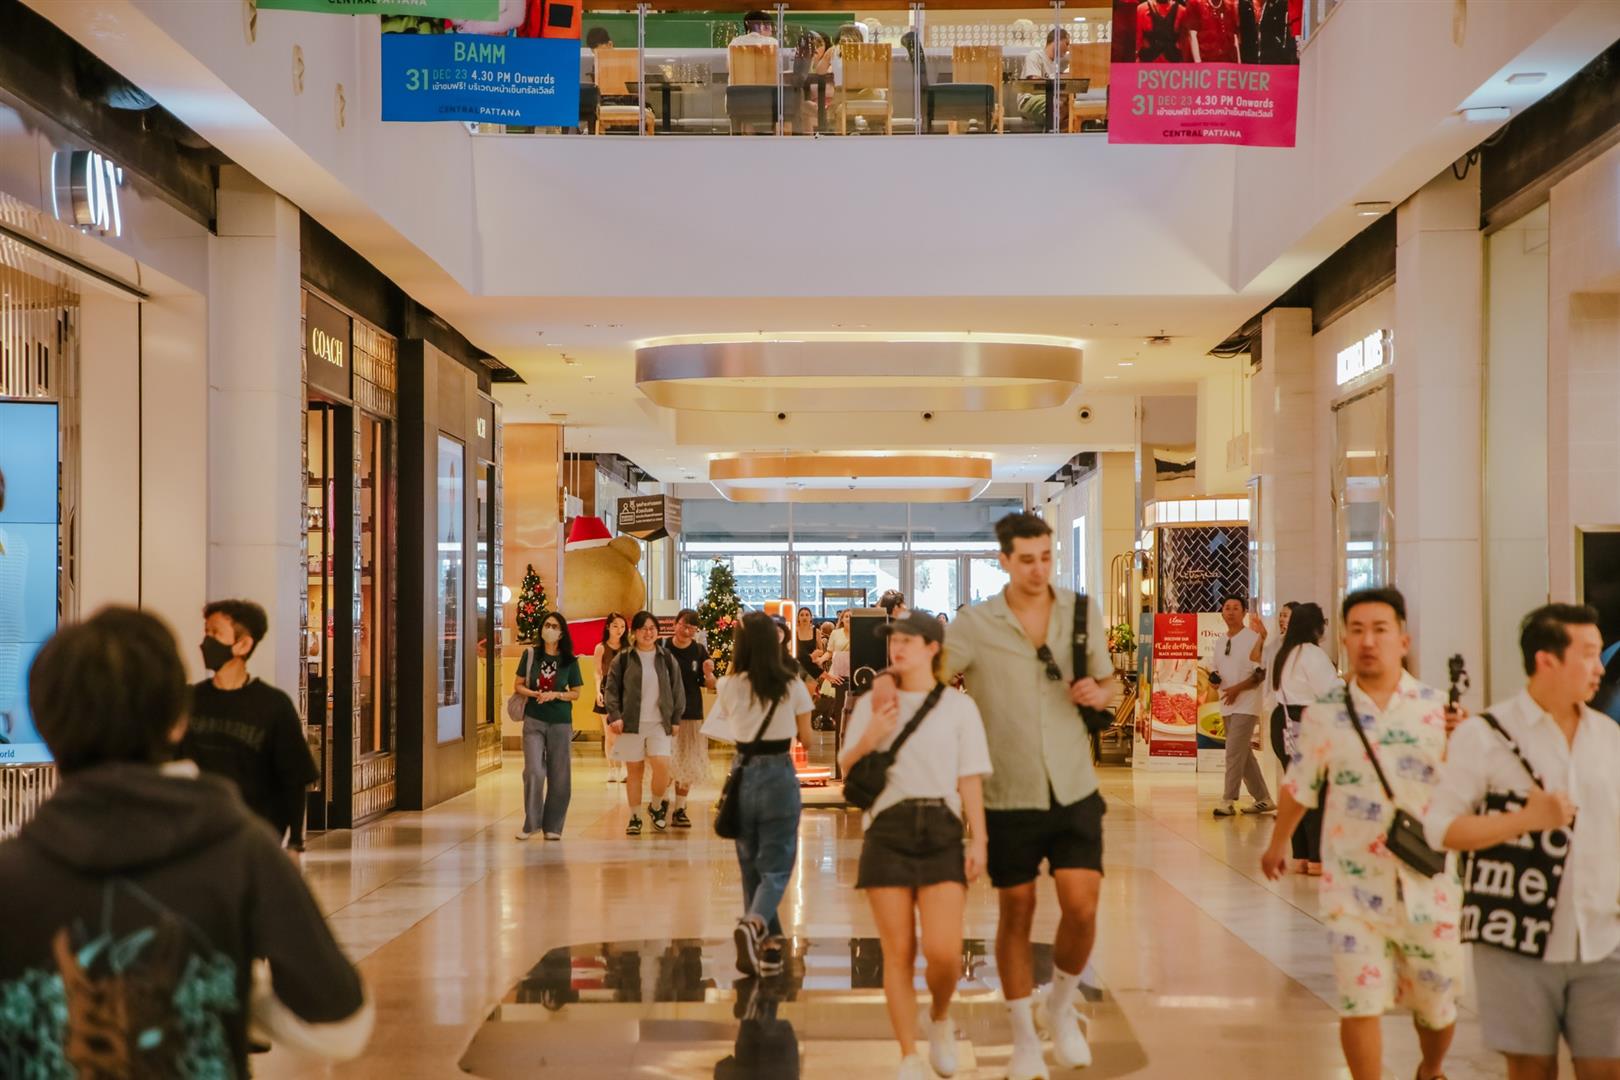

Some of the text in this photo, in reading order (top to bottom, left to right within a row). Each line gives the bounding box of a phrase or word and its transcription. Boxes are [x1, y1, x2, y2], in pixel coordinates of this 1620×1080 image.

[454, 41, 505, 64] BAMM
[406, 68, 555, 91] 31 DEC 23 4.30 PM Onwards
[1137, 69, 1270, 91] PSYCHIC FEVER
[1131, 95, 1154, 116] 31
[1158, 95, 1177, 106] DEC
[1195, 95, 1218, 106] 4.30
[1220, 95, 1233, 106] PM
[1236, 96, 1274, 108] Onwards
[313, 327, 343, 368] COACH
[0, 749, 15, 758] orld
